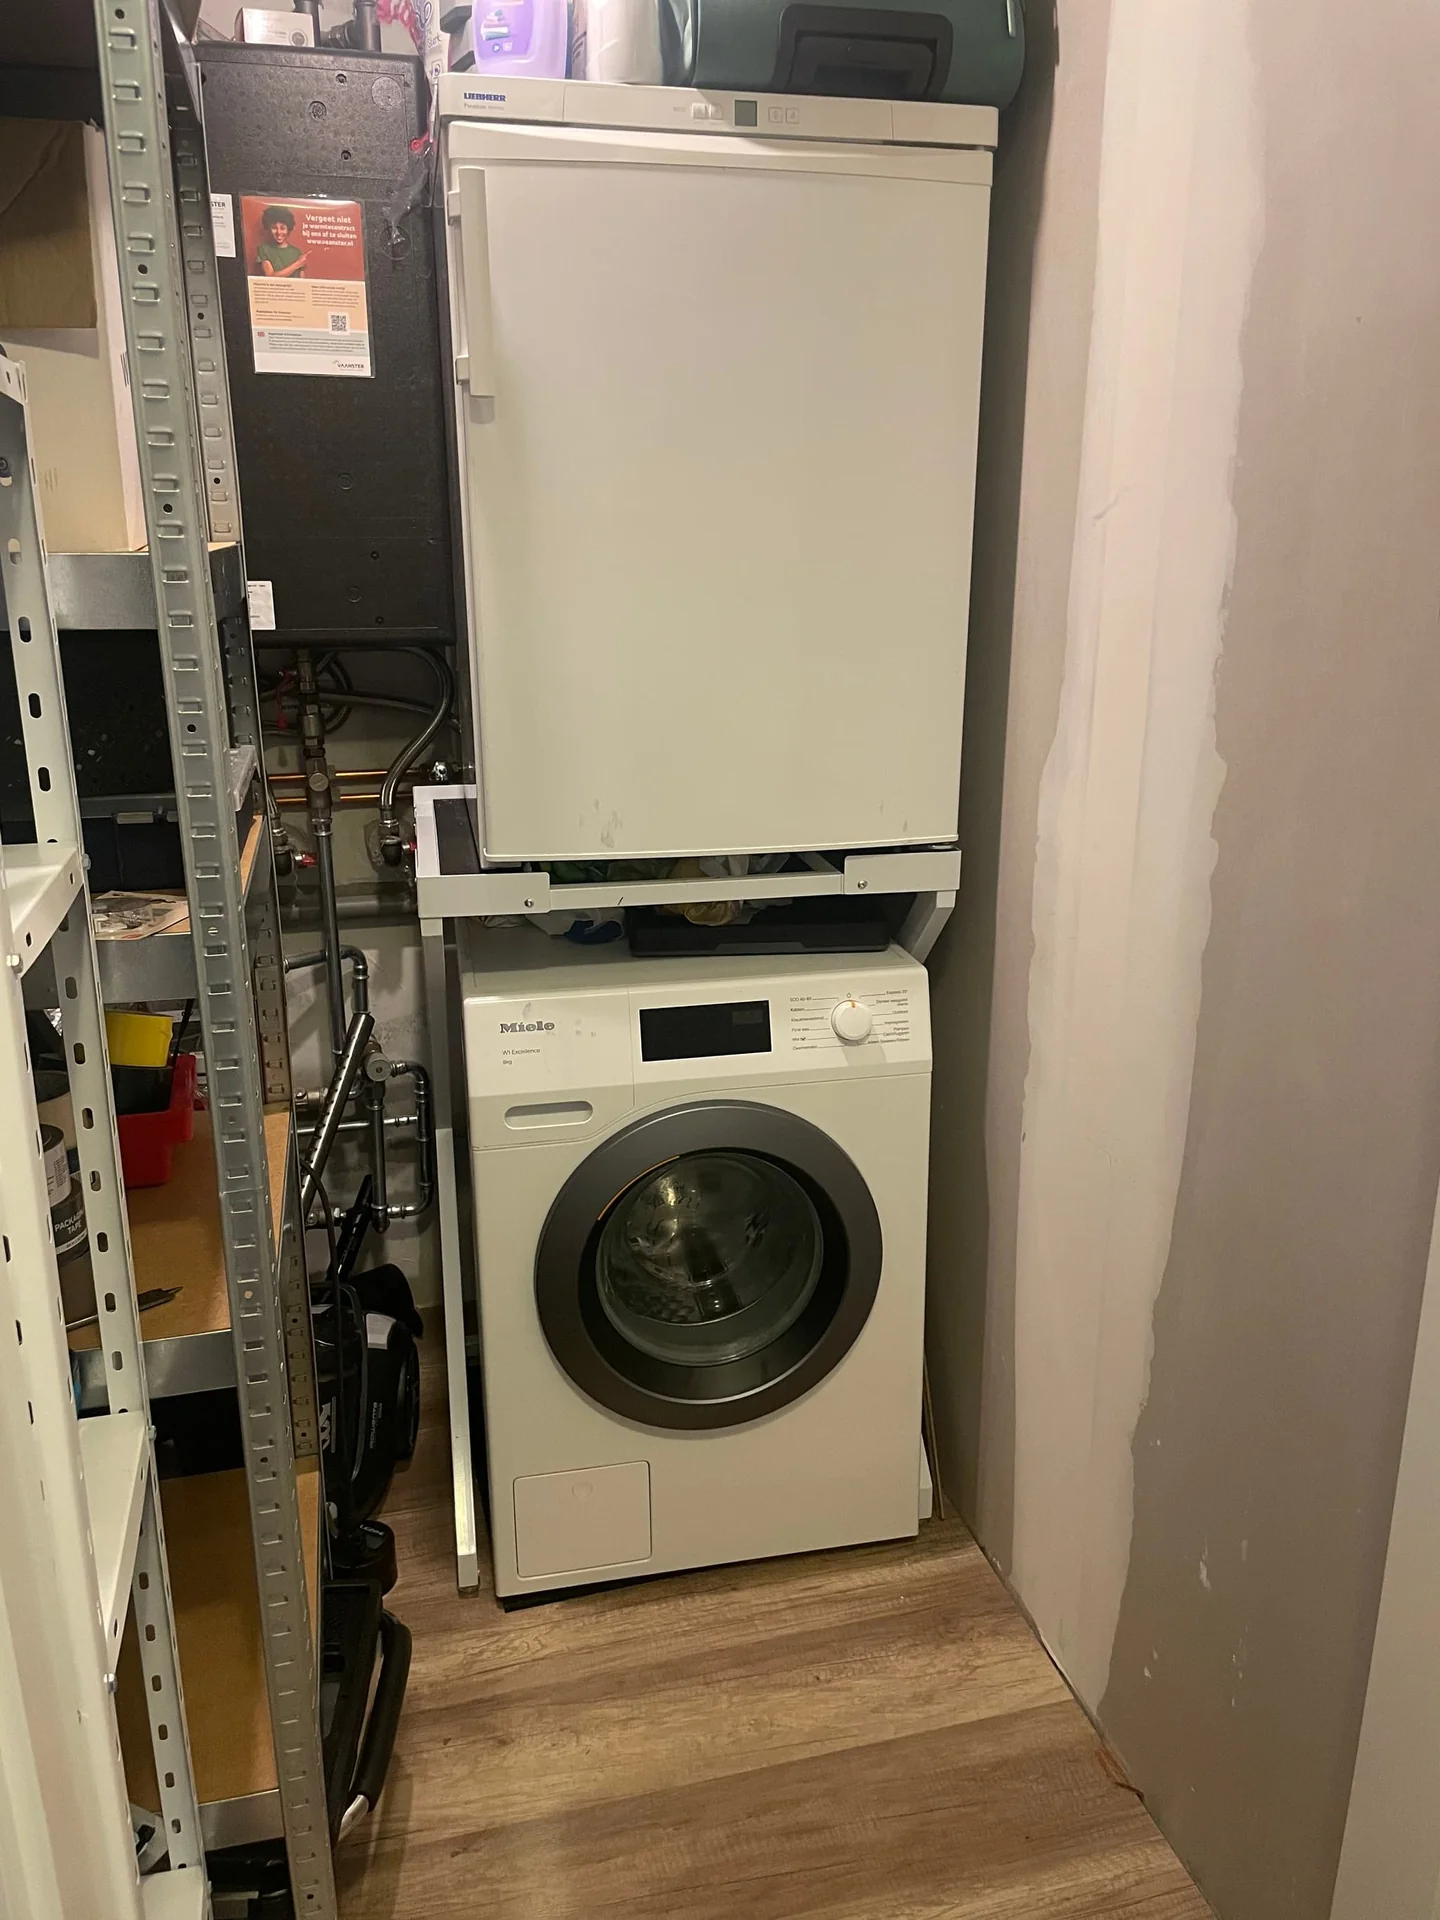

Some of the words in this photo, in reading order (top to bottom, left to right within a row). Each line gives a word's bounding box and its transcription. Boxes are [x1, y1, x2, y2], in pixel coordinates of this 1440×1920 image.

[463, 92, 506, 102] LIEBHERR
[305, 214, 336, 223] Vergeet
[336, 215, 351, 224] niet
[306, 239, 354, 247] www.vaanster.nl
[499, 1020, 555, 1034] Miele
